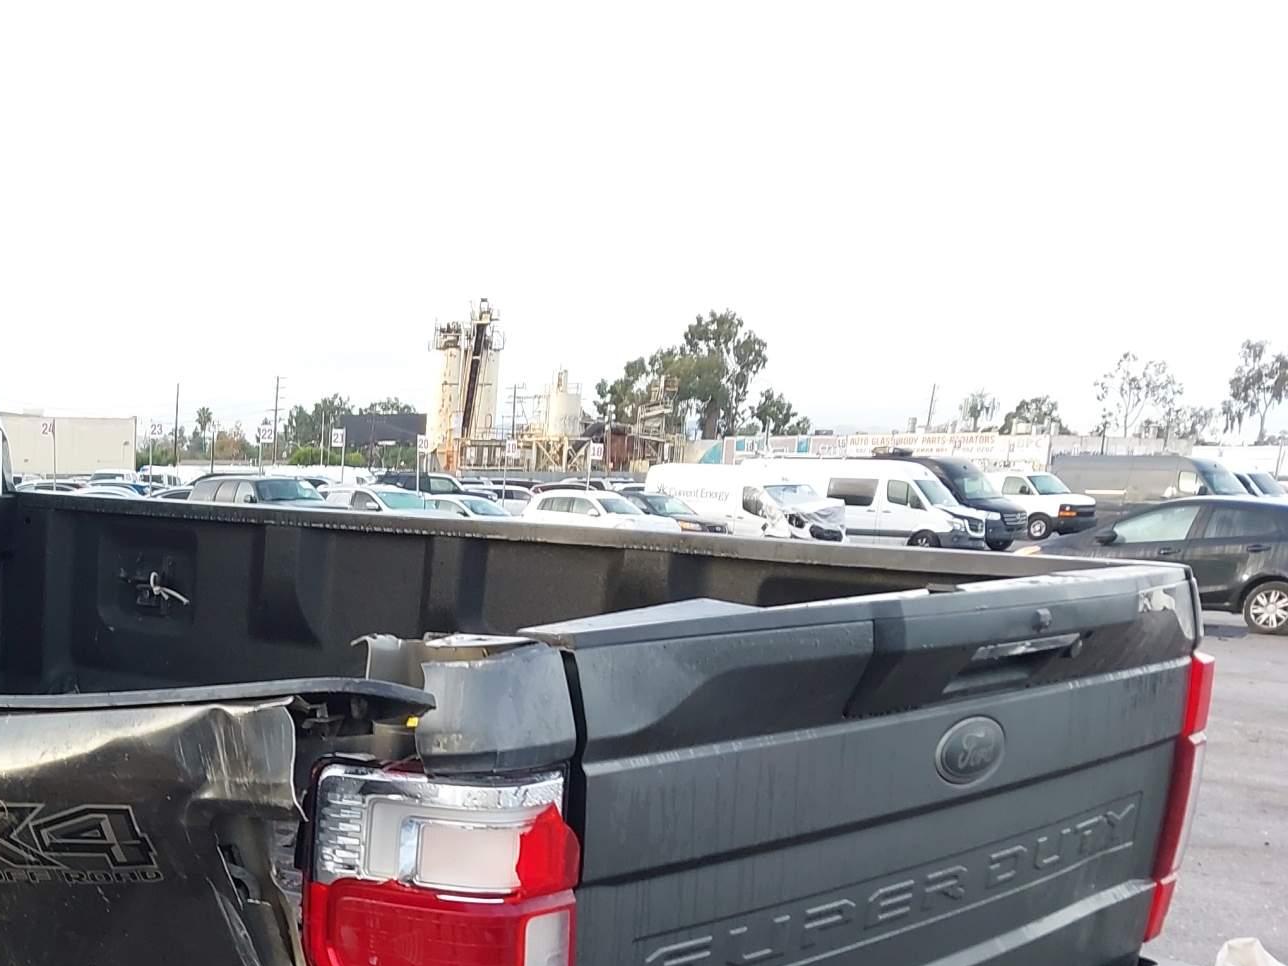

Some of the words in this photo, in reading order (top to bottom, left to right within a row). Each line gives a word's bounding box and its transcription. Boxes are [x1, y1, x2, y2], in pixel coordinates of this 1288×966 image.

[150, 423, 163, 436] 23
[261, 428, 273, 440] 22
[418, 438, 429, 449] 20
[850, 436, 869, 446] AUTO
[986, 803, 1136, 889] DUTY
[63, 869, 164, 884] ROAD
